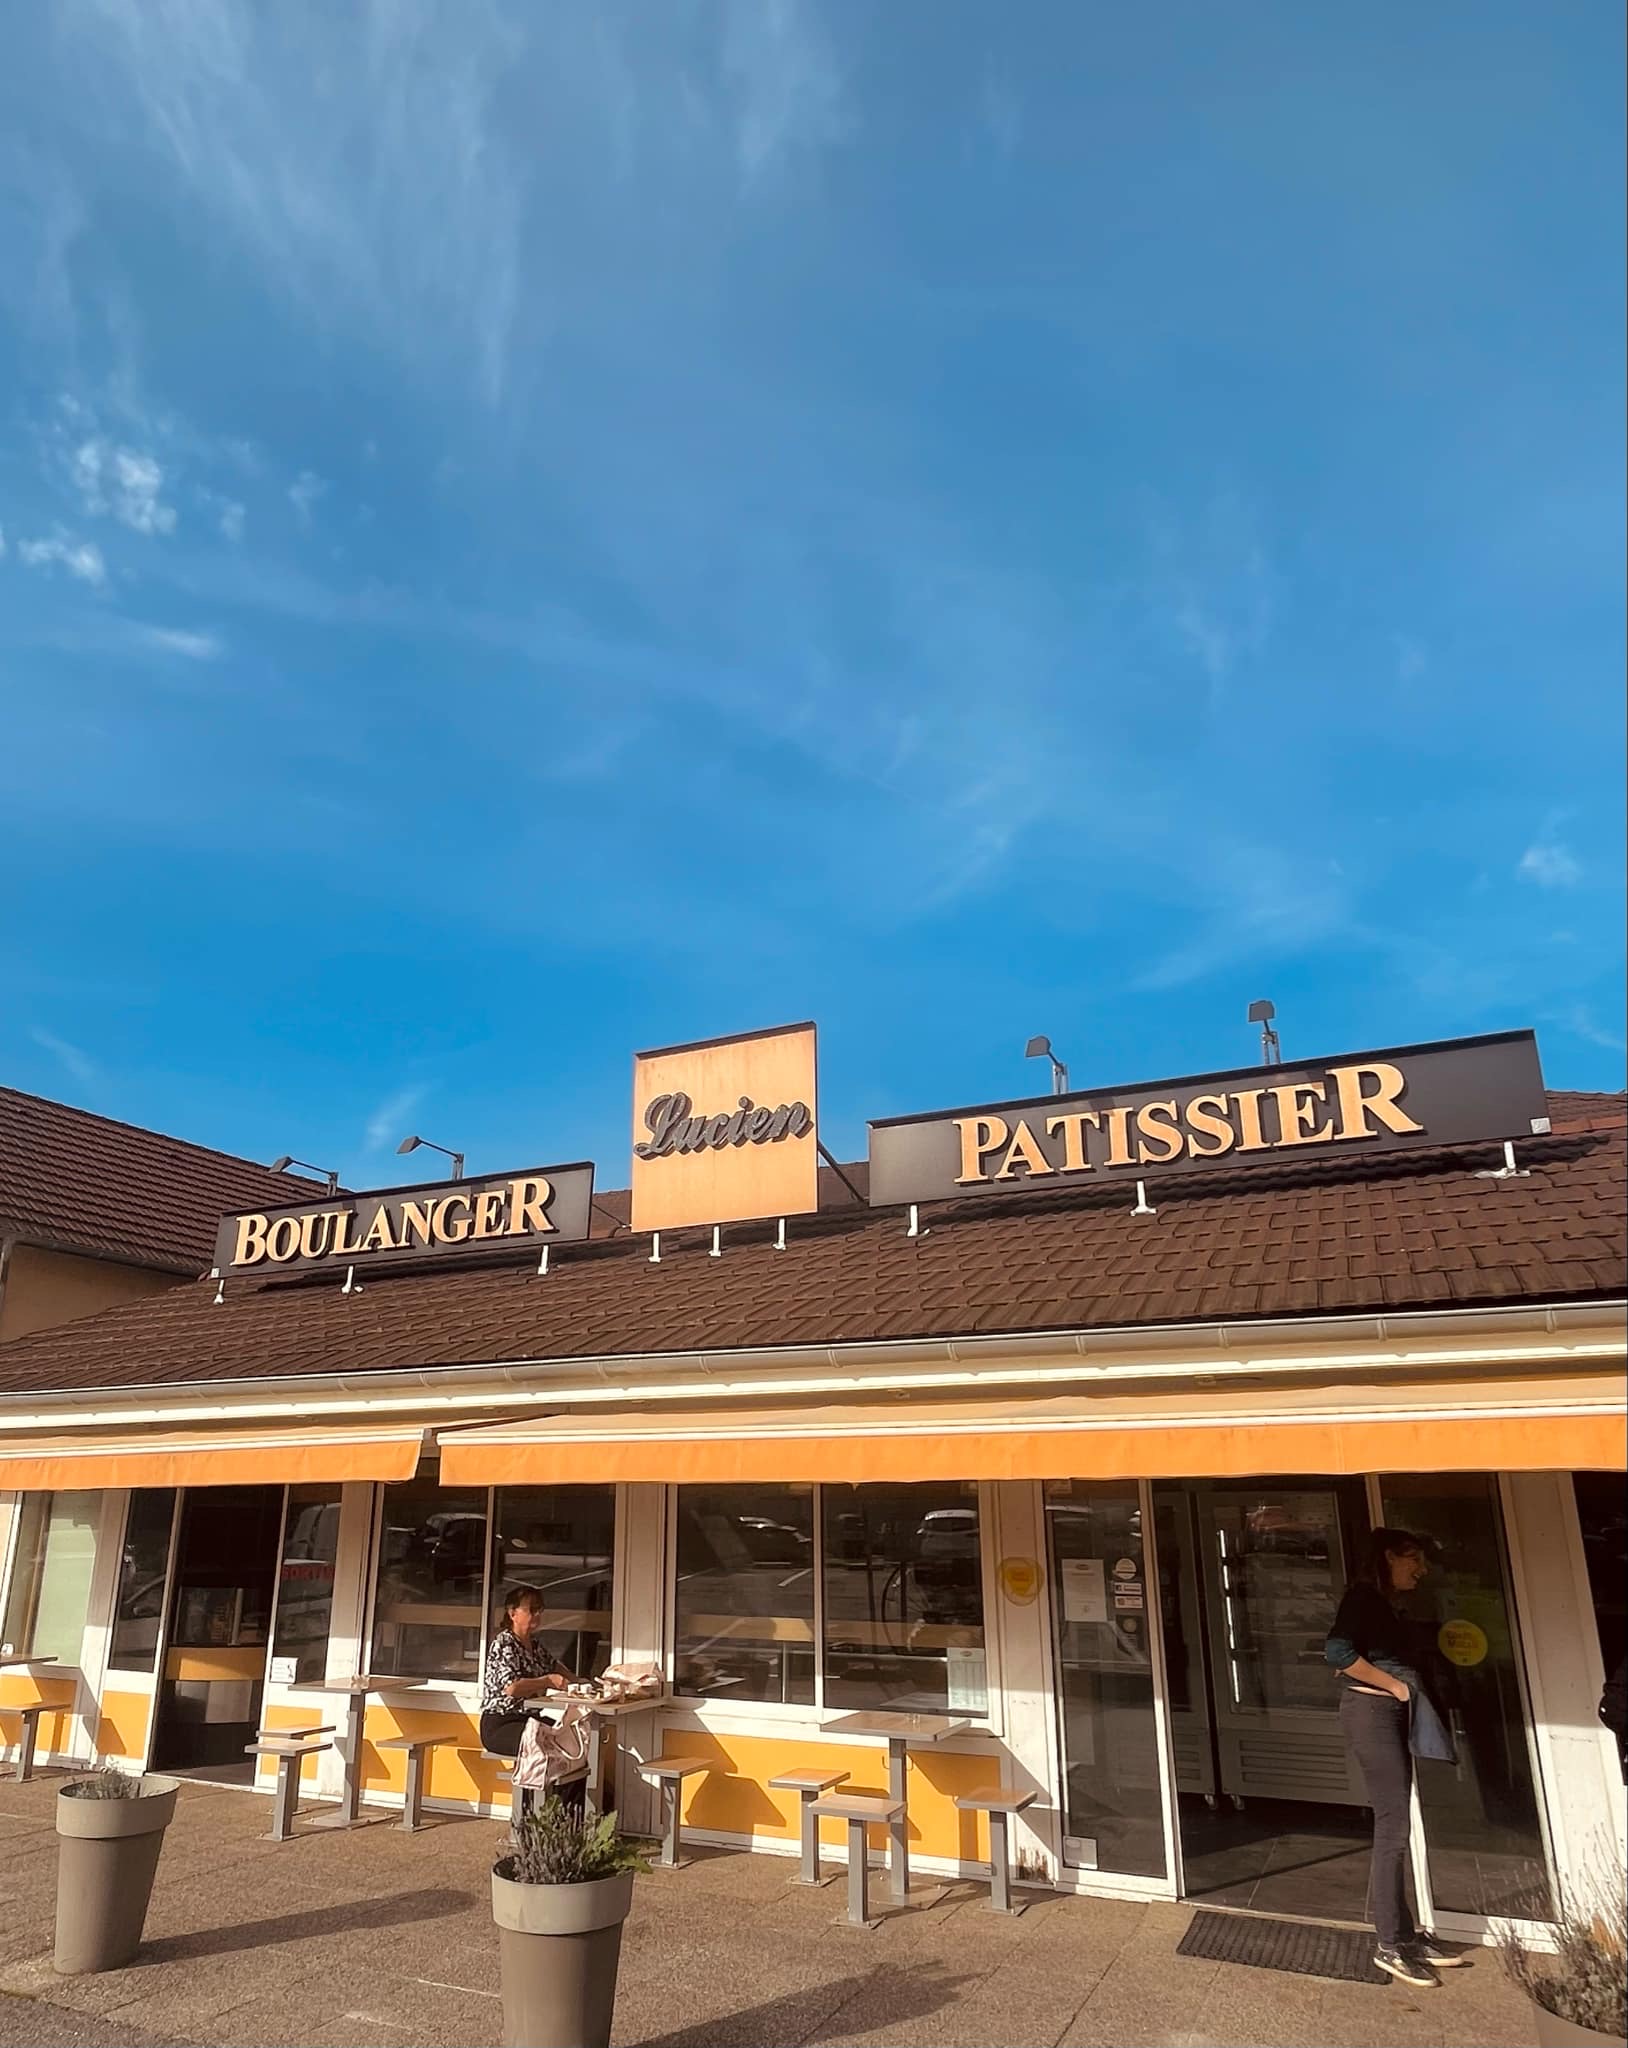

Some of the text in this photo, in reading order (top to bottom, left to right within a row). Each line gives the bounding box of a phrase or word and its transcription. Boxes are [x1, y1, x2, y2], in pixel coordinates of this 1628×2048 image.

[634, 1092, 814, 1159] Lucien
[953, 1063, 1423, 1184] PATISSIER
[231, 1177, 557, 1266] BOULANGER
